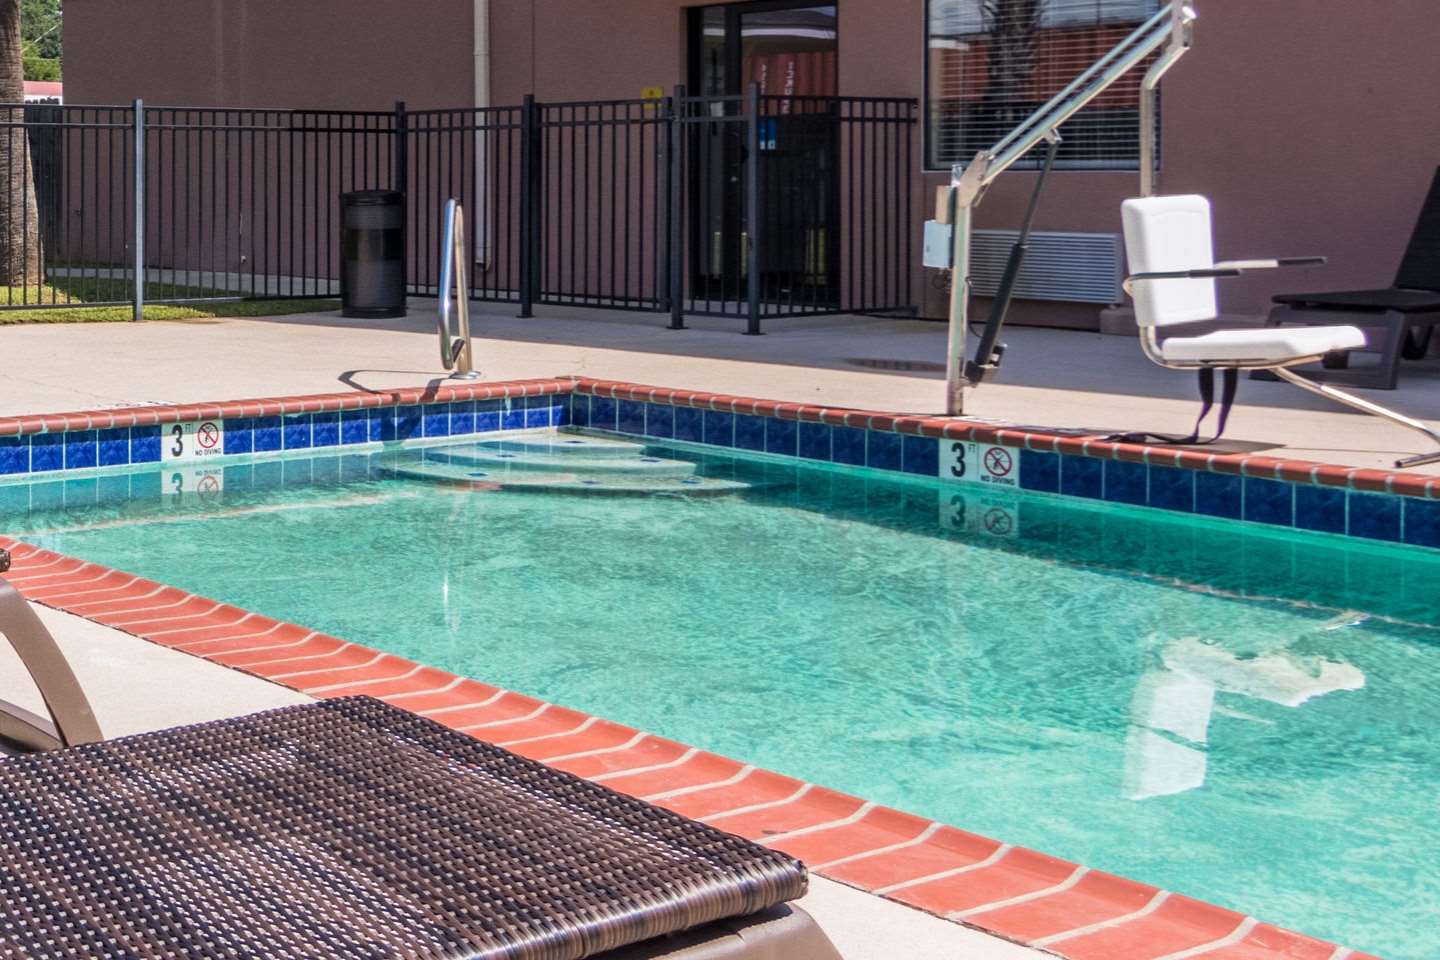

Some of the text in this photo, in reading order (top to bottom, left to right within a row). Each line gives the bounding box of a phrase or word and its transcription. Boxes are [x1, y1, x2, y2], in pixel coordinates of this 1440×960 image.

[171, 423, 192, 457] 3 FT
[204, 448, 222, 456] DIVING
[951, 442, 976, 477] 3 FT
[980, 474, 1015, 486] NO DIVING
